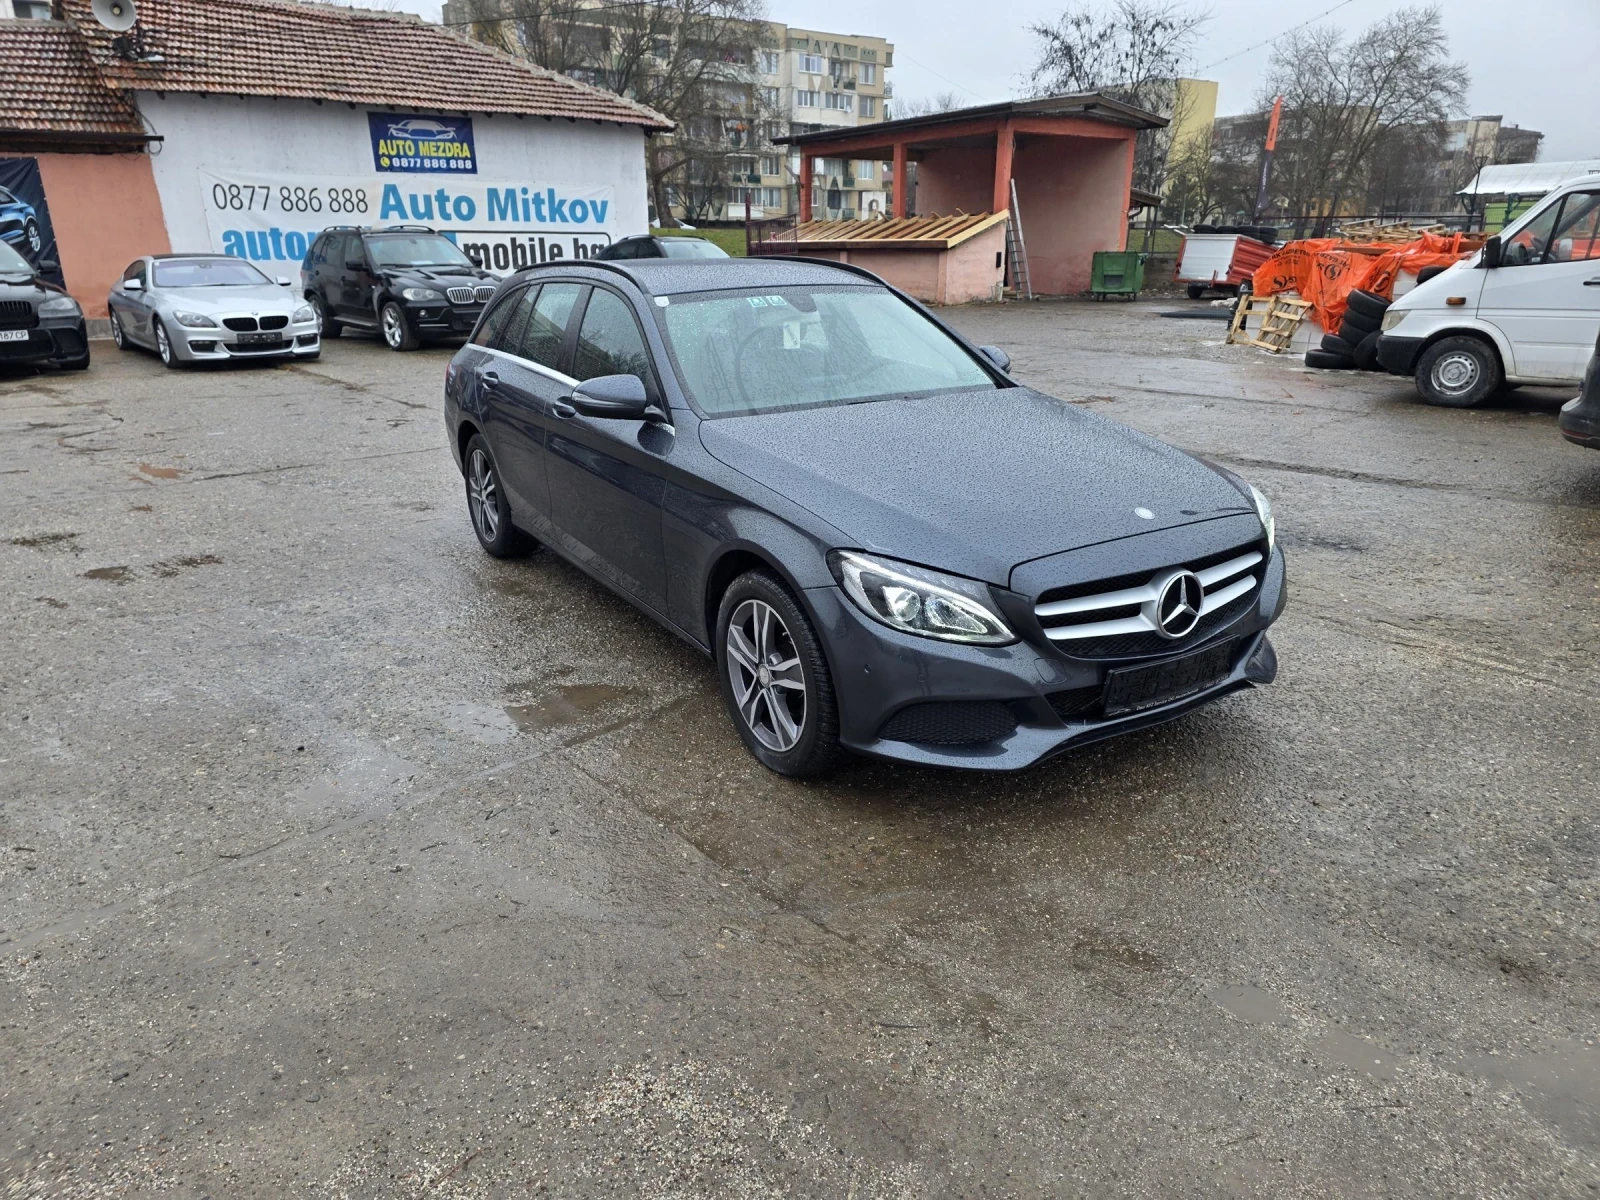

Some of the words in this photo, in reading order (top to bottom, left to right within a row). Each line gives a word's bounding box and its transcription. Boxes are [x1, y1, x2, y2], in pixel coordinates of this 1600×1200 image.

[379, 139, 415, 156] AUTO
[418, 141, 471, 158] MEZDRA
[392, 158, 421, 168] 0877
[424, 159, 447, 169] 886
[449, 160, 472, 169] 888
[213, 183, 270, 211] 0877
[279, 186, 322, 213] 886
[328, 188, 368, 214] 888
[380, 184, 476, 222] Auto
[487, 187, 608, 224] Mitkov
[222, 227, 320, 262] auto
[463, 237, 606, 271] mobileb
